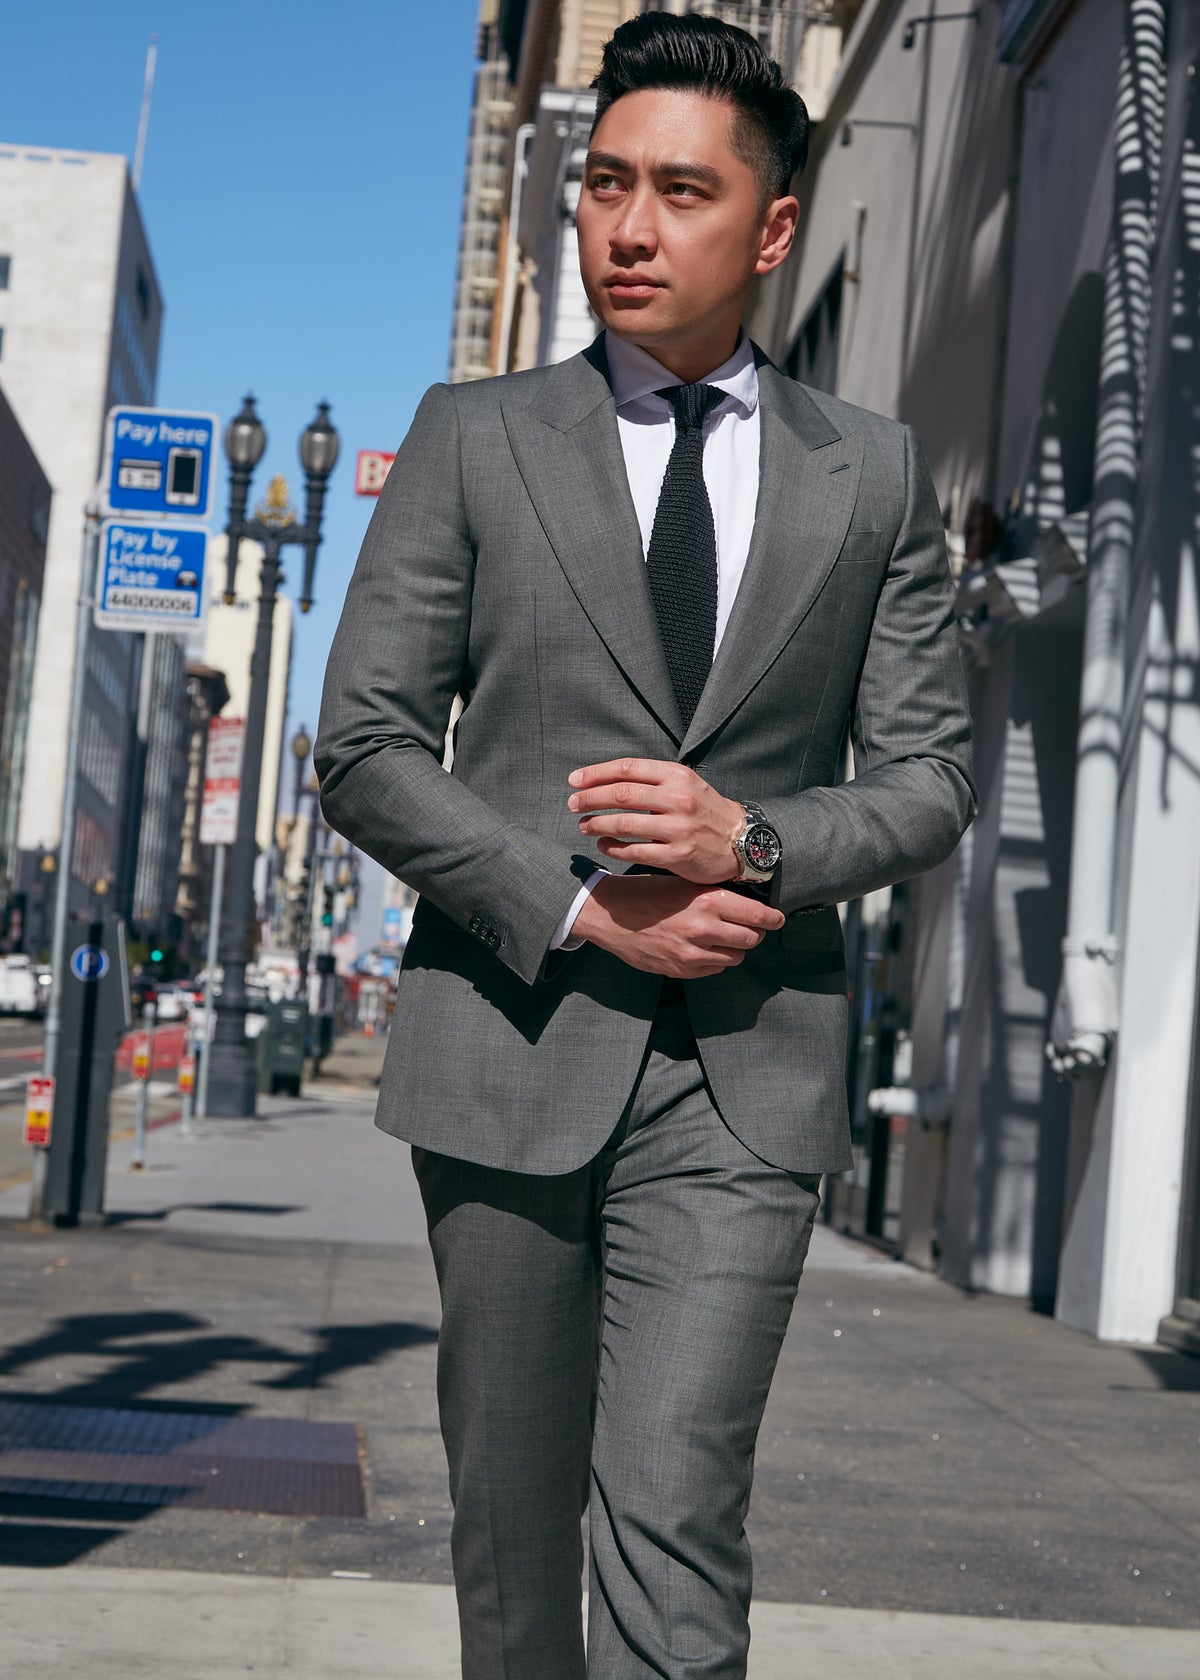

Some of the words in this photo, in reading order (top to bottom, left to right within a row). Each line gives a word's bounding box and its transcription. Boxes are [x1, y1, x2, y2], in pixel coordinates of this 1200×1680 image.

[117, 419, 157, 446] Pay
[159, 421, 209, 446] here
[111, 528, 148, 551] Pay
[151, 530, 178, 555] by
[109, 547, 182, 571] License
[107, 566, 159, 588] Plate
